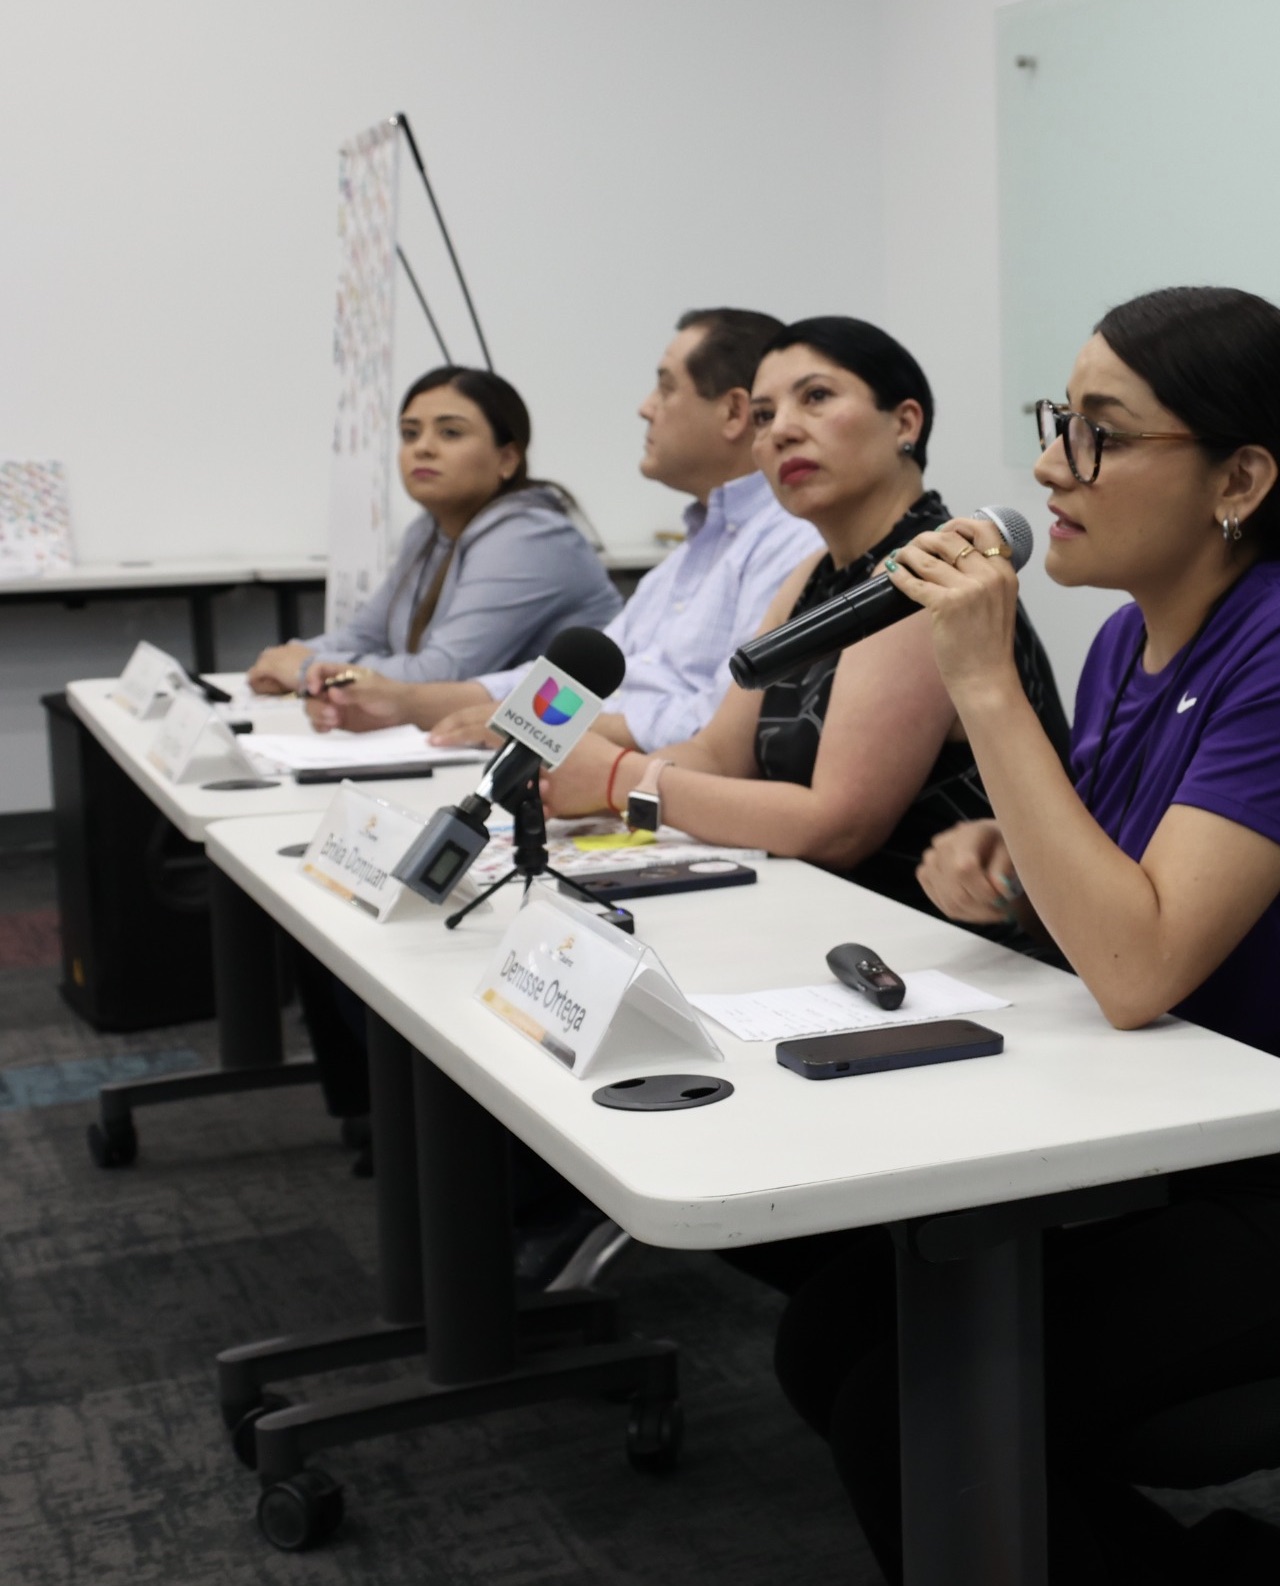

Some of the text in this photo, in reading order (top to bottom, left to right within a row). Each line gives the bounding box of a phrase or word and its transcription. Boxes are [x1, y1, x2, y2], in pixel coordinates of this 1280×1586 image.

[504, 708, 562, 754] NOTICIAS
[500, 950, 587, 1034] Denisse Ortega
